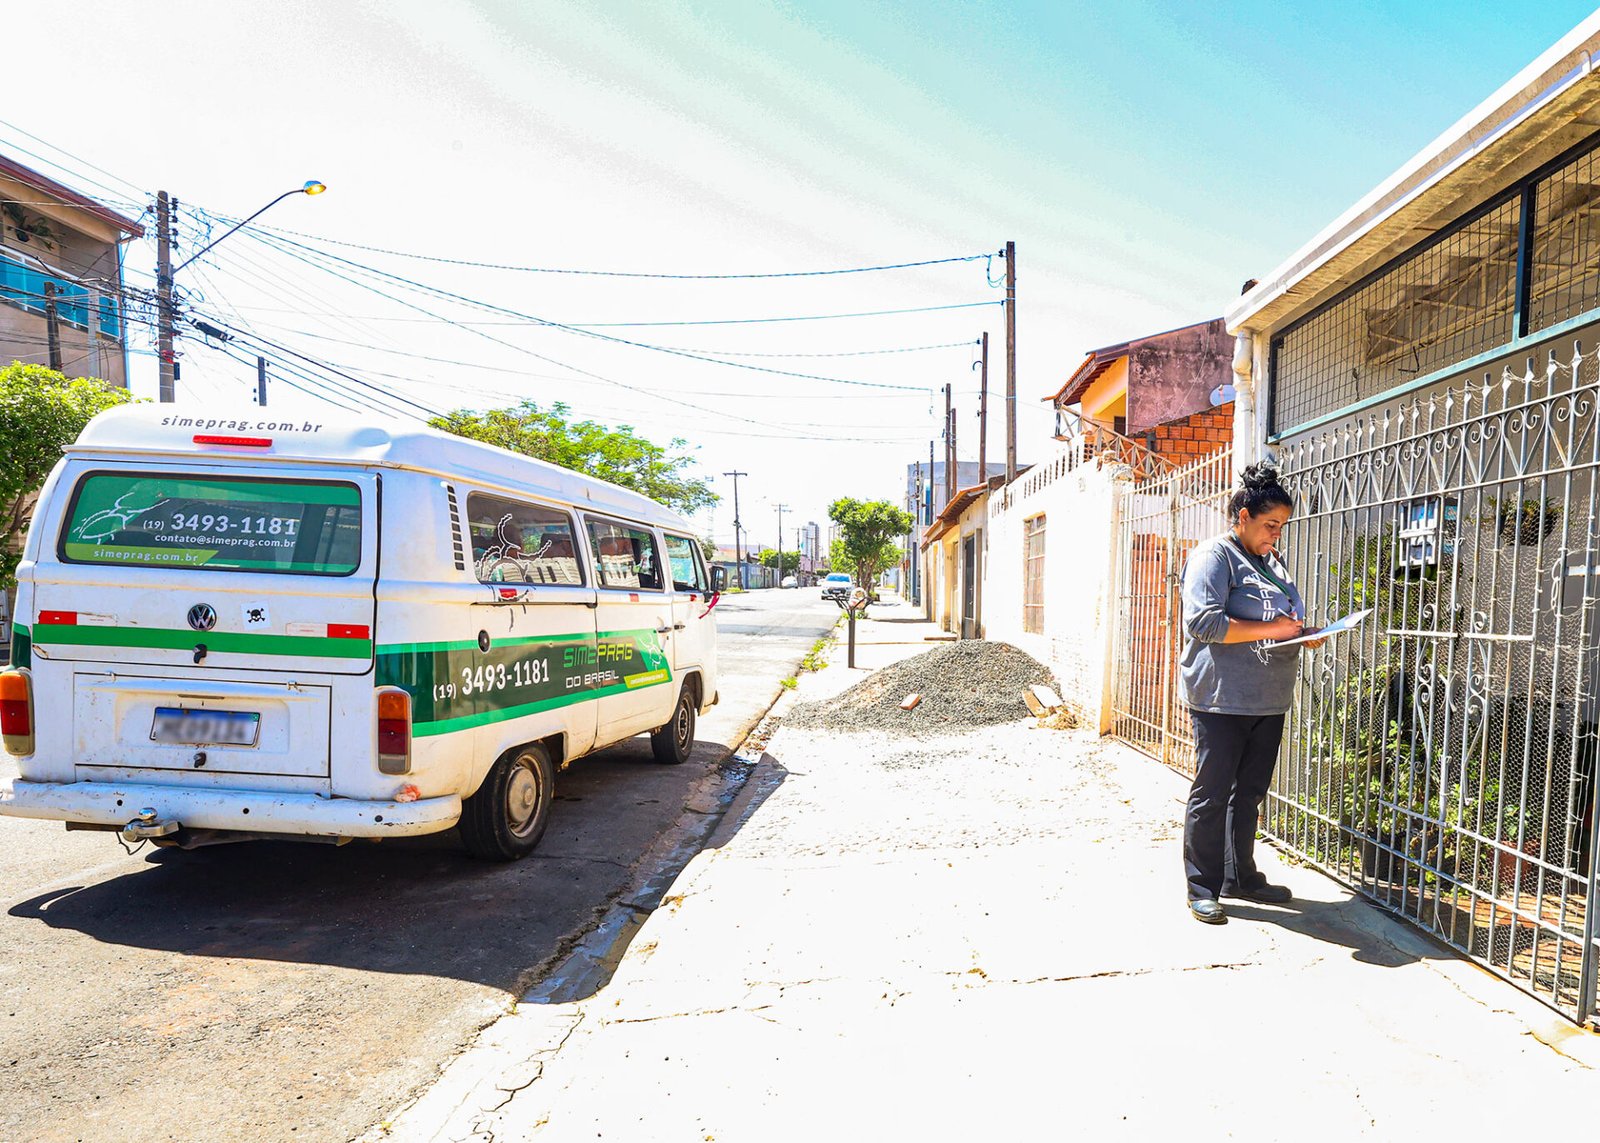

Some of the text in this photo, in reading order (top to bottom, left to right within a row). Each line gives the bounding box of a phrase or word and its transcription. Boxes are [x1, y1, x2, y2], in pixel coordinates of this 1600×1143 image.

[161, 415, 322, 433] simeprag.com.br
[143, 513, 296, 535] (19) 3493-1181
[154, 534, 296, 548] contato@simeprag.com.br
[94, 549, 199, 562] simeprag.com.br
[563, 643, 633, 668] SIMEPRAG
[433, 658, 549, 701] (19) 3493-1181
[565, 675, 581, 688] DO
[584, 670, 619, 685] BRASIL
